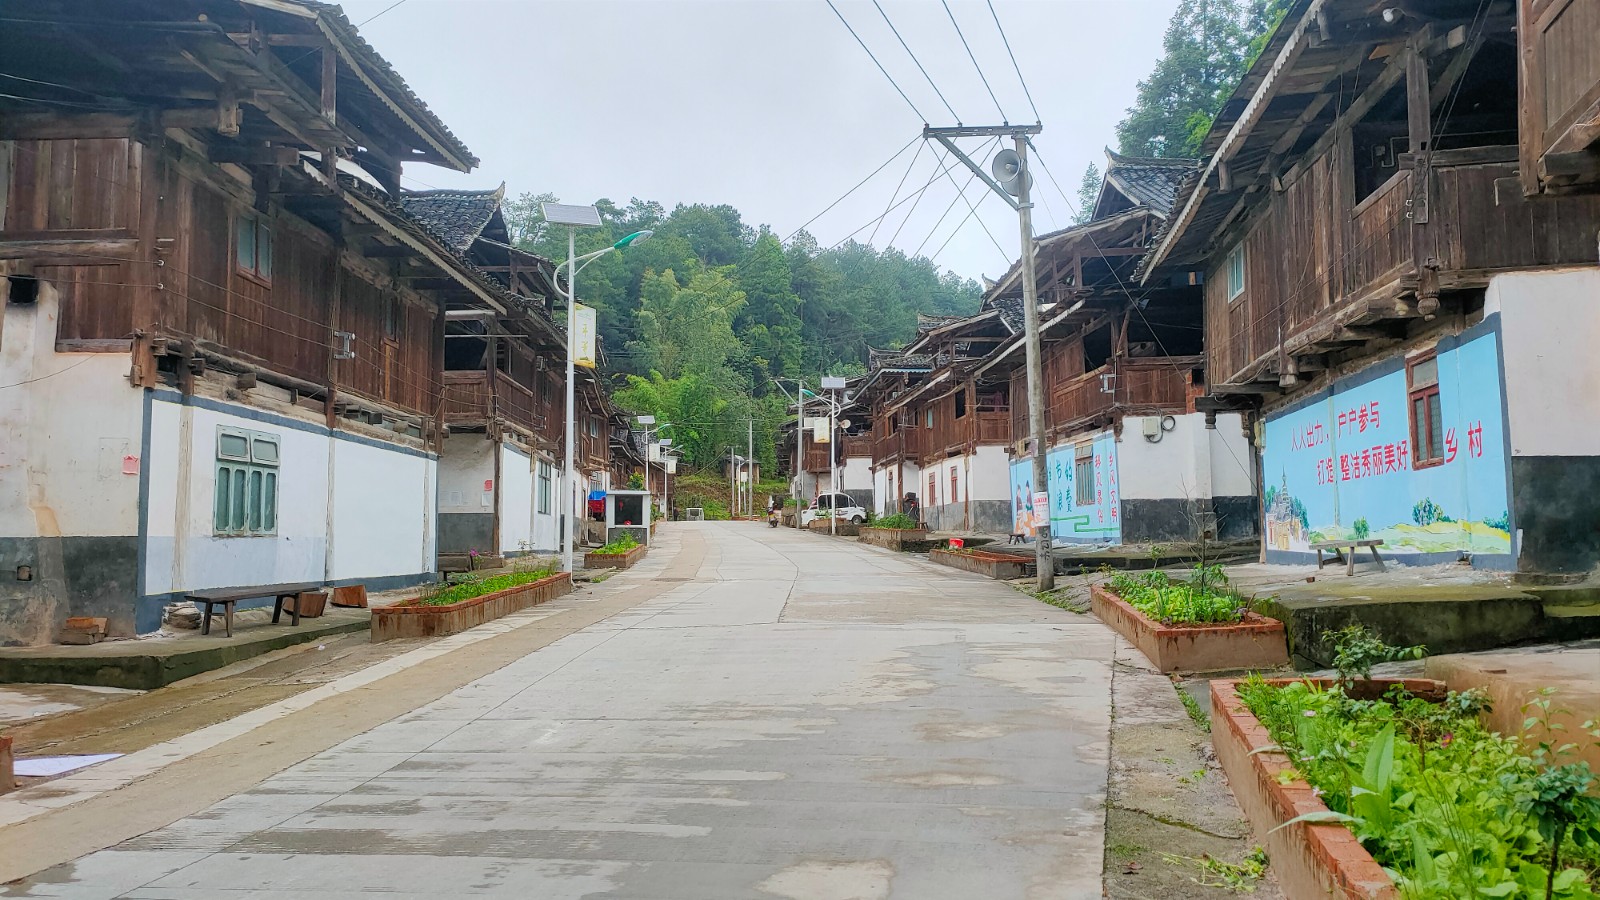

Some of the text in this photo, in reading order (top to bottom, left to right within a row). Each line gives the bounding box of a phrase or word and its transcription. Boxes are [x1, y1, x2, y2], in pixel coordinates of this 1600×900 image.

[1317, 420, 1482, 485] 打造整洁秀丽美好 乡村
